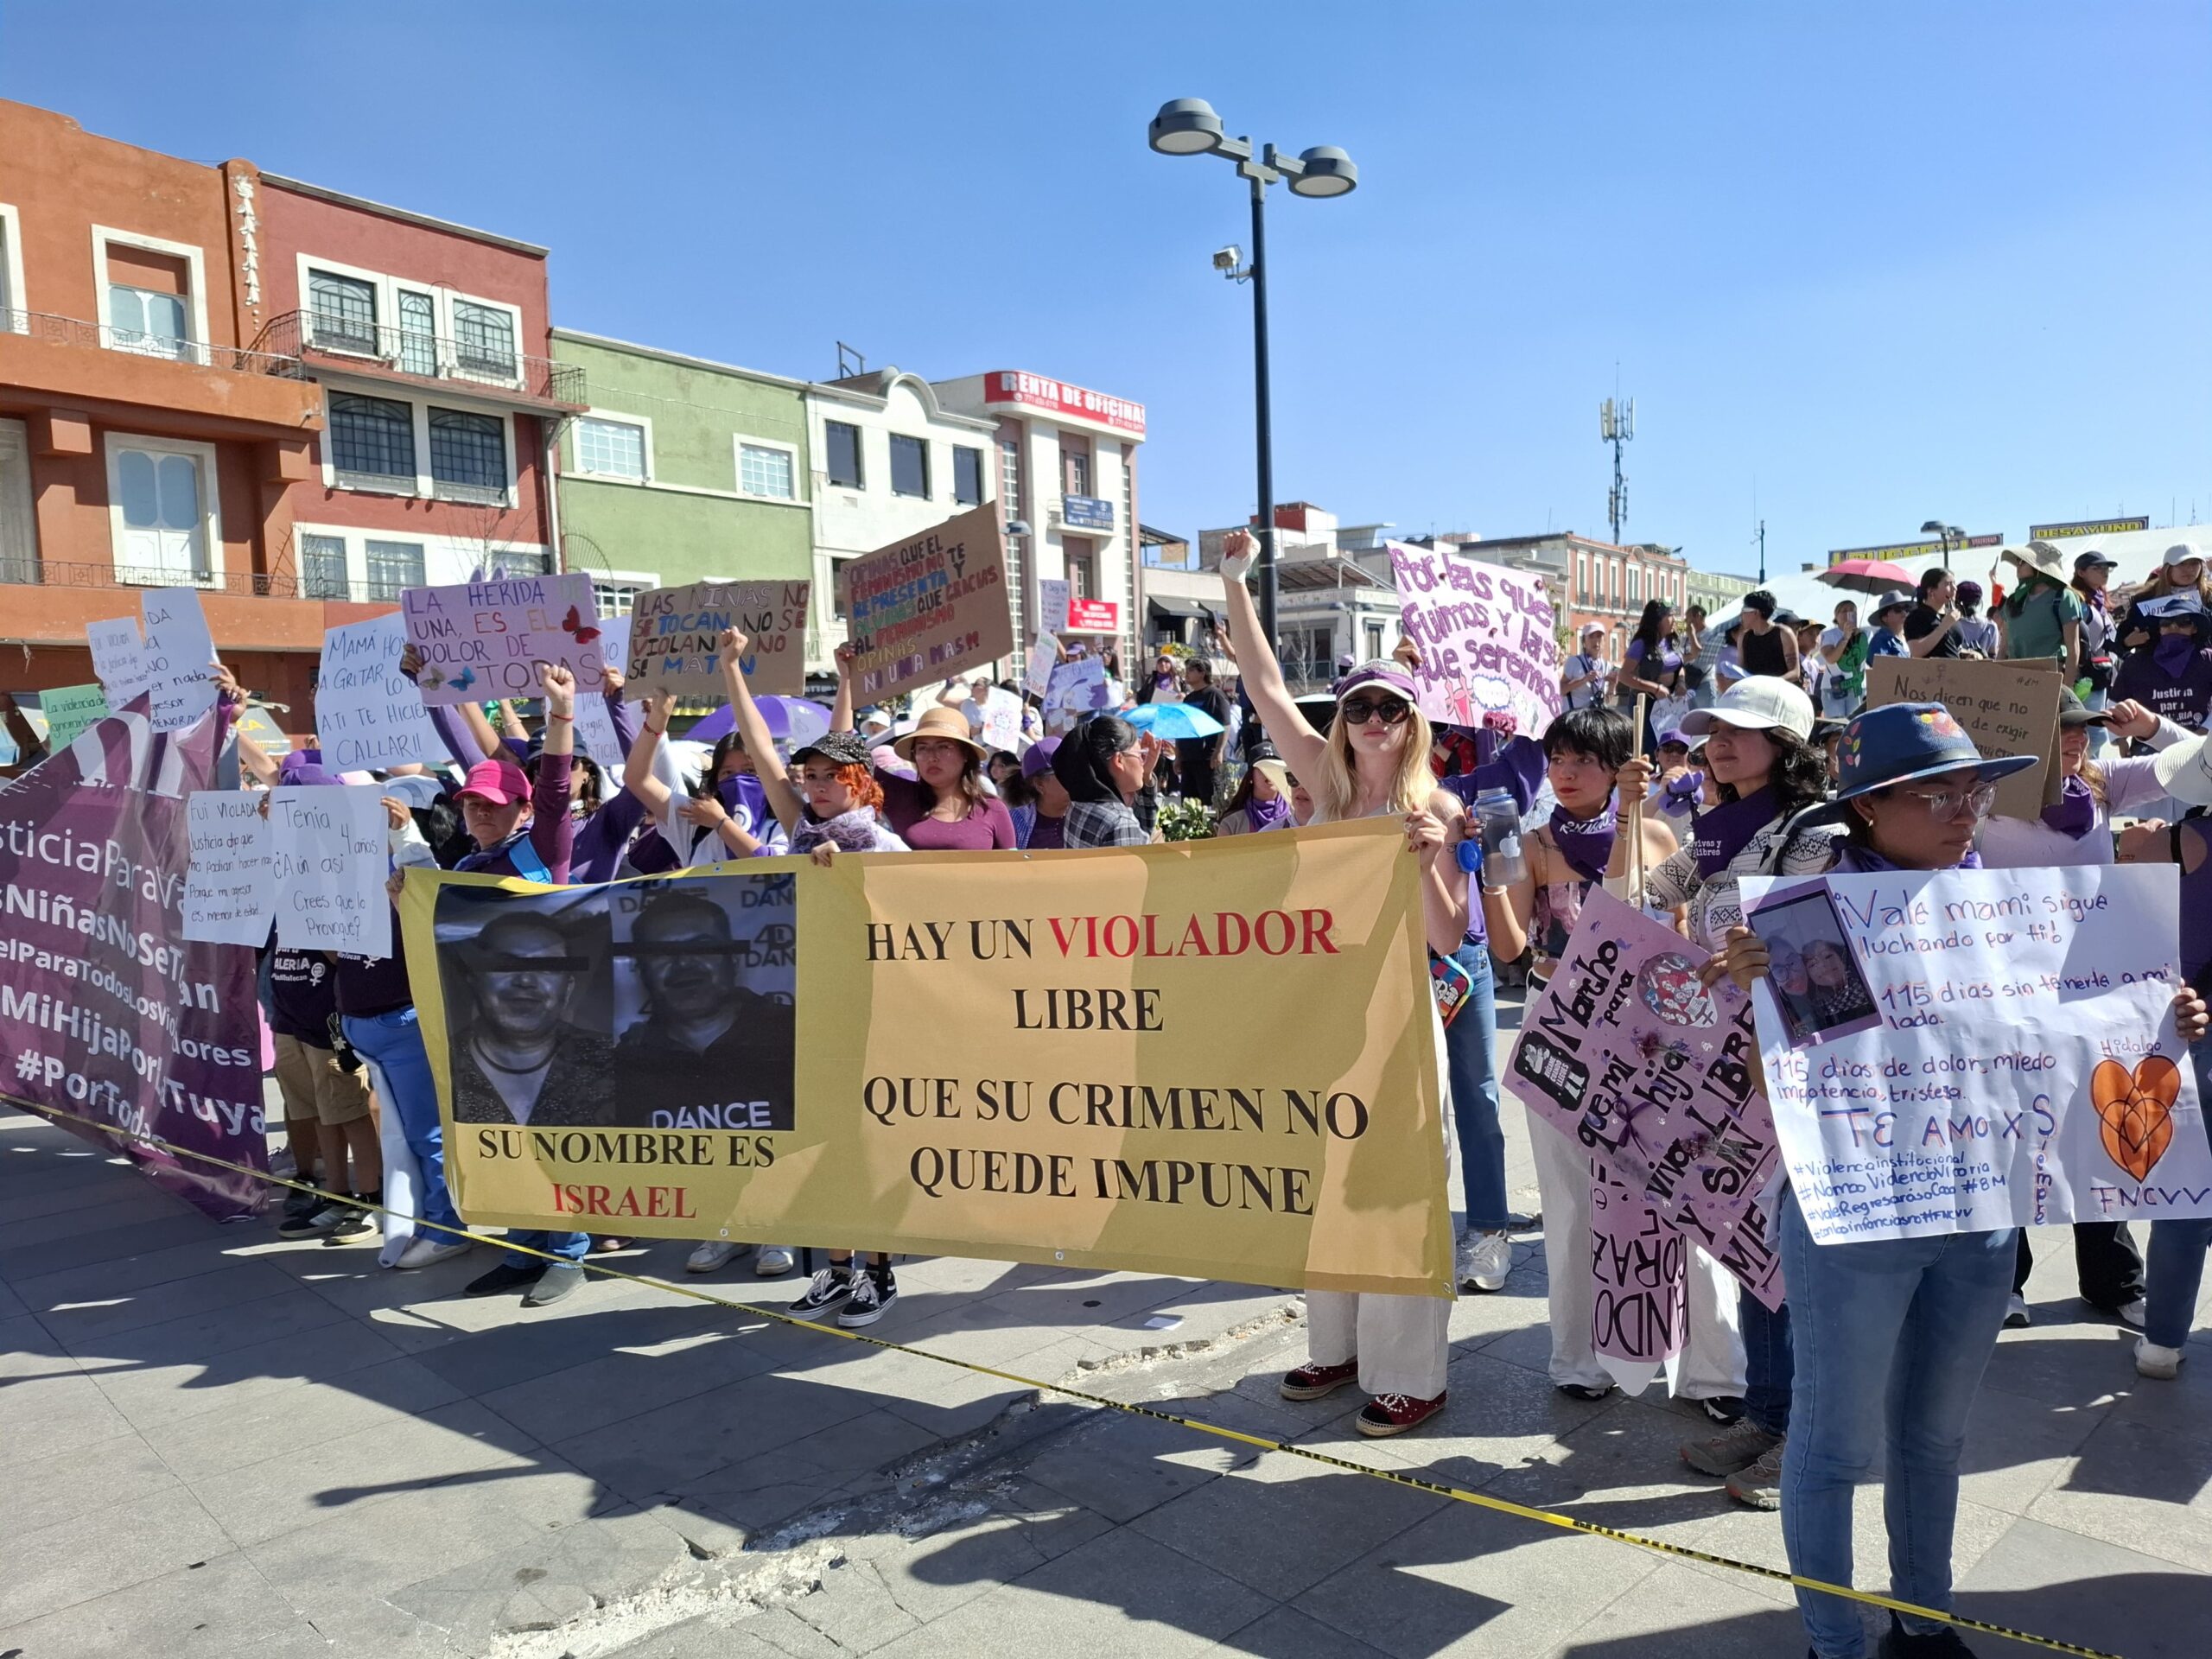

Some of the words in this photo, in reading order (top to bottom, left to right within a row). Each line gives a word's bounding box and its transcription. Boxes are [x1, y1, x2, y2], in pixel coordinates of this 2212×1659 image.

[1001, 372, 1059, 401] RENTA
[1062, 386, 1082, 407] DE
[900, 540, 925, 565] QUE
[926, 534, 944, 556] EL
[946, 543, 966, 563] TE
[953, 560, 965, 579] Y
[410, 590, 443, 615] LA
[467, 580, 545, 607] HERIDA
[639, 594, 675, 617] LAS
[783, 583, 810, 608] NO
[917, 588, 943, 614] QUE
[1441, 552, 1493, 601] las
[1499, 578, 1555, 629] que
[474, 612, 508, 634] ES
[526, 608, 560, 632] EL
[633, 619, 654, 638] SE
[658, 611, 731, 636] TOCAN
[743, 611, 772, 633] NO
[779, 609, 806, 632] SE
[419, 639, 491, 664] DOLOR
[506, 632, 536, 658] DE
[632, 634, 717, 657] VIOLAN
[756, 634, 787, 653] NO
[173, 670, 207, 687] nada
[628, 658, 649, 680] SE
[662, 654, 757, 677] MATN
[864, 669, 883, 694] NI
[888, 653, 925, 685] UNA
[1893, 674, 1927, 702] Nos
[1933, 688, 1974, 707] dicen
[1978, 698, 2001, 715] que
[2009, 702, 2029, 715] no
[355, 707, 377, 727] TE
[1971, 716, 1989, 731] de
[216, 802, 257, 819] VIOLADA
[340, 822, 352, 855] 4
[293, 890, 330, 912] Crees
[334, 895, 353, 914] que
[1945, 893, 2032, 922] mami
[2042, 890, 2108, 923] sigue
[865, 921, 956, 962] HAY
[968, 918, 1035, 959] UN
[1046, 907, 1342, 958] VIOLADOR
[1861, 930, 1974, 960] luchando
[1539, 939, 1619, 1053] Marcho
[1603, 969, 1637, 1028] para
[1880, 981, 1934, 1011] 115
[1940, 981, 1994, 1003] dias
[2002, 978, 2035, 997] sin
[2121, 972, 2137, 985] a
[2141, 963, 2171, 982] mi
[1013, 988, 1165, 1032] LIBRE
[2100, 1034, 2163, 1058] Hidalgo
[1821, 1052, 1875, 1080] dias
[1883, 1057, 1912, 1078] de
[1993, 1051, 2057, 1072] miedo
[652, 1101, 772, 1130] DANCE
[864, 1075, 962, 1126] QUE
[976, 1078, 1035, 1123] SU
[1048, 1081, 1267, 1134] CRIMEN
[1281, 1088, 1370, 1141] NO
[1821, 1107, 1897, 1148] TE
[1921, 1115, 1990, 1148] AMO
[478, 1129, 523, 1160] SU
[532, 1131, 716, 1166] NOMBRE
[726, 1134, 775, 1168] ES
[910, 1146, 1077, 1198] QUEDE
[1090, 1156, 1314, 1217] IMPUNE
[551, 1183, 697, 1219] ISRAEL
